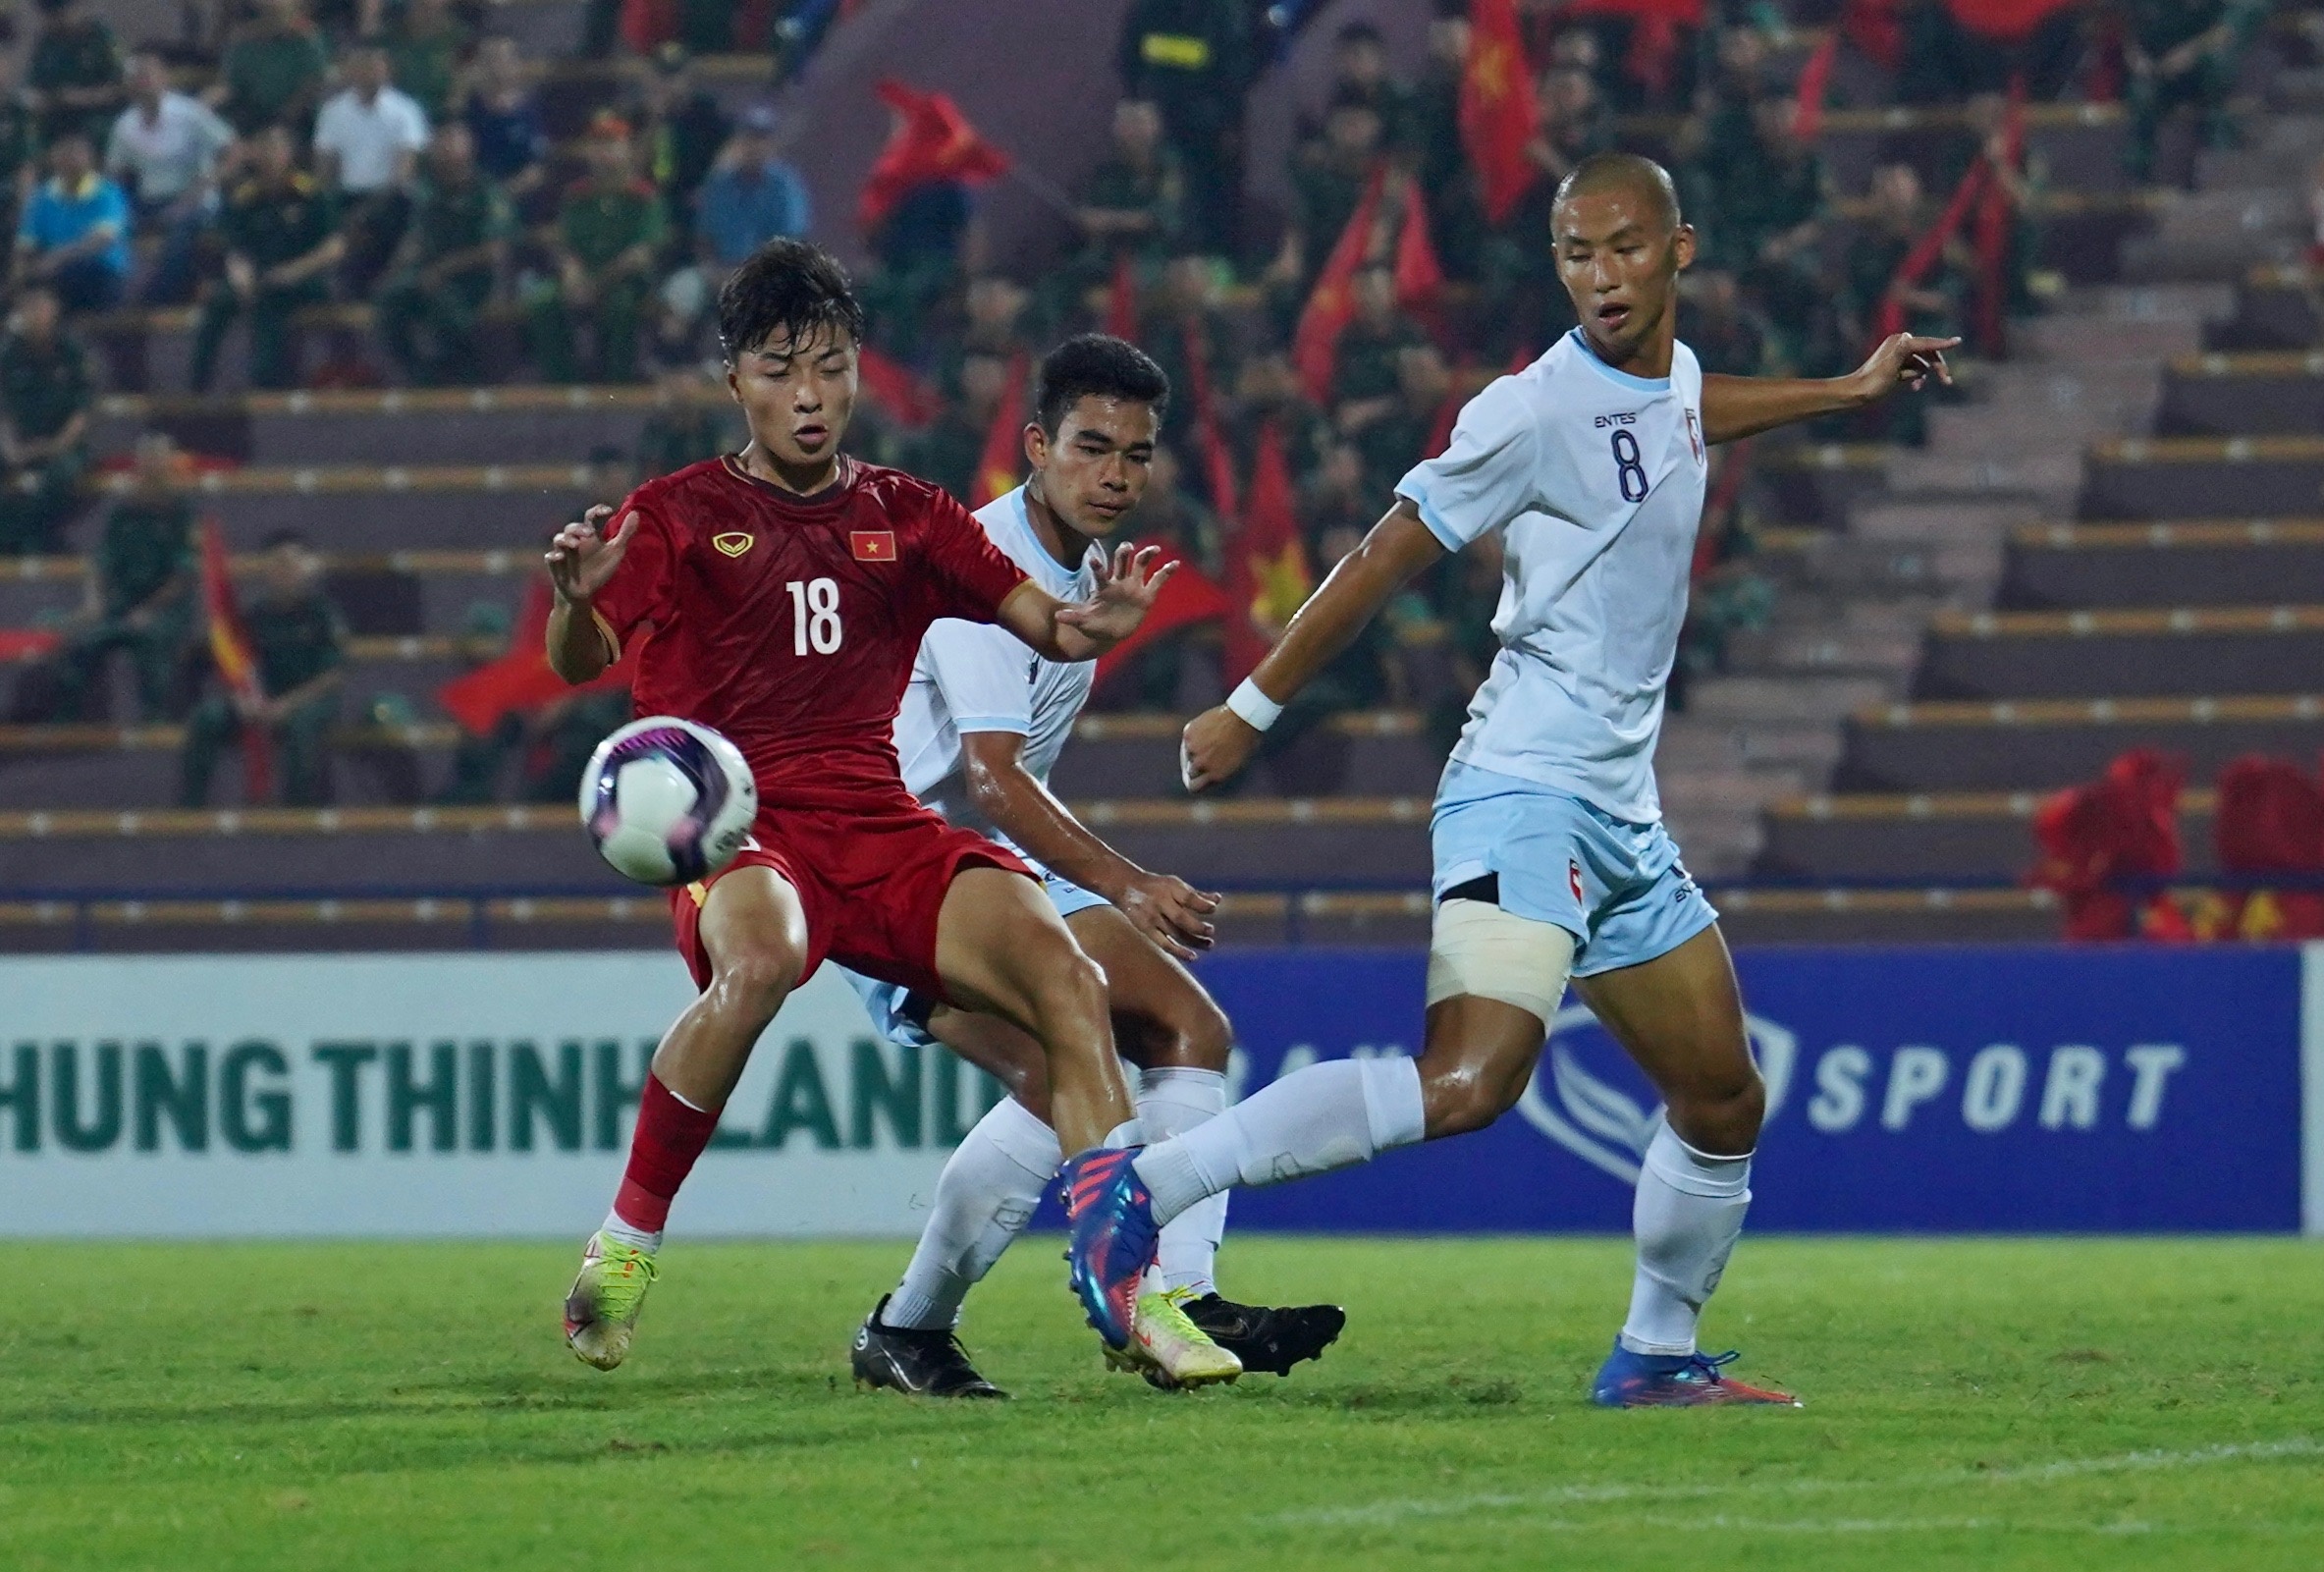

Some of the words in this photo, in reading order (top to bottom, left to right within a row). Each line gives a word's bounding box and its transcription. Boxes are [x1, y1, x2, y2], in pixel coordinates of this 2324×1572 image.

[1594, 411, 1637, 428] ENTES
[1610, 428, 1649, 503] 8
[785, 576, 842, 657] 18
[0, 1038, 294, 1155] HUNG
[310, 1038, 664, 1154] THINH
[1807, 1044, 2187, 1133] SPORT
